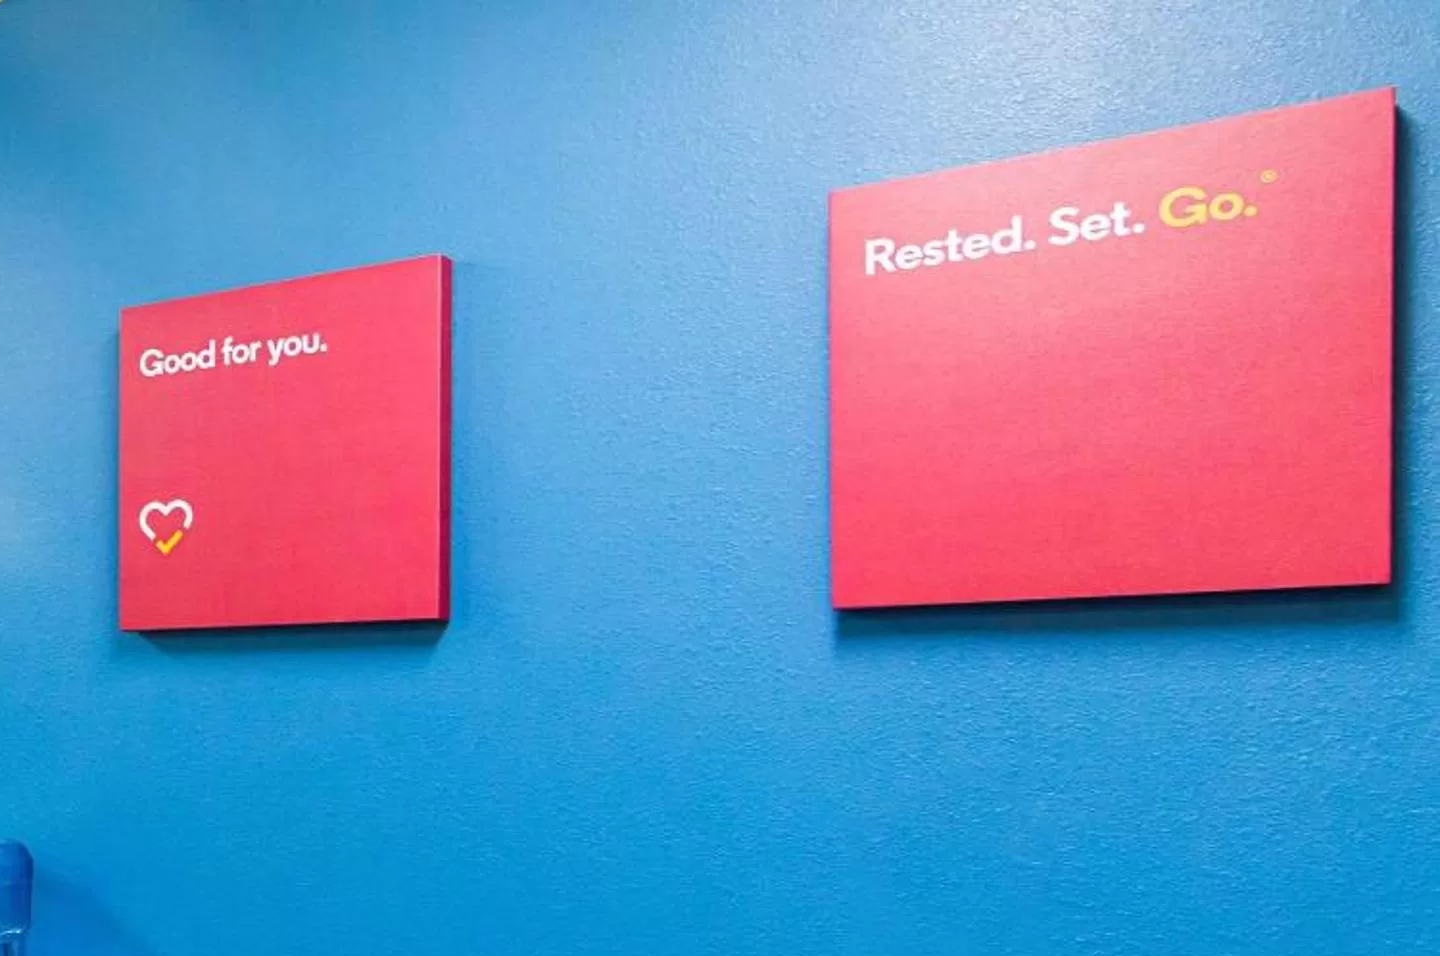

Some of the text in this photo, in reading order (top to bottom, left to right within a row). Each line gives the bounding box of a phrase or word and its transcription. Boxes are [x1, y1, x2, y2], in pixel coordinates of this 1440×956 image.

[863, 214, 1037, 275] Rested.
[1047, 201, 1146, 247] Set.
[139, 332, 328, 378] Good for you.
